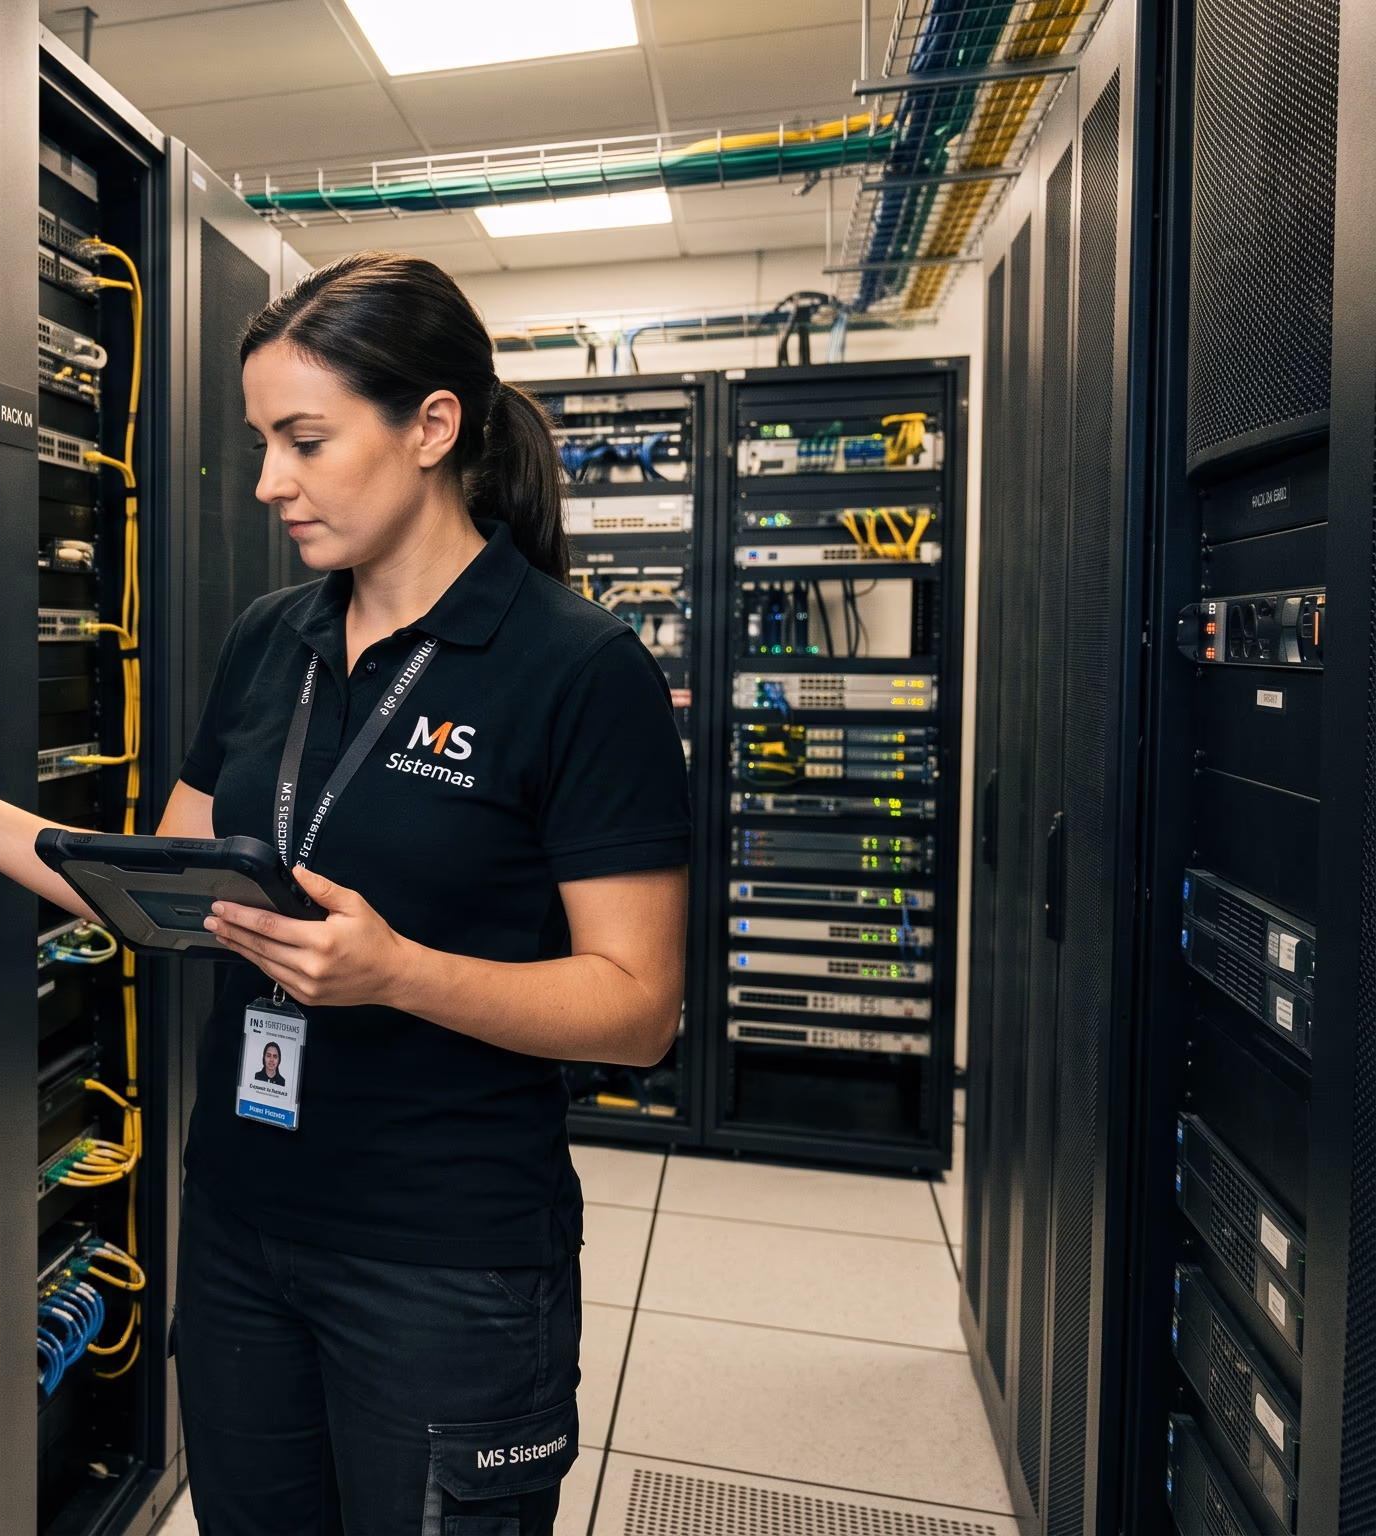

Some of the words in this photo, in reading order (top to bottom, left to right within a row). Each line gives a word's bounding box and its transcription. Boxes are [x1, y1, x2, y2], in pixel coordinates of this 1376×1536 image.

[1, 405, 23, 426] RACK
[406, 715, 476, 760] MS
[385, 752, 476, 788] Sistemas
[477, 1448, 506, 1469] MS
[509, 1434, 568, 1464] Sistemas
